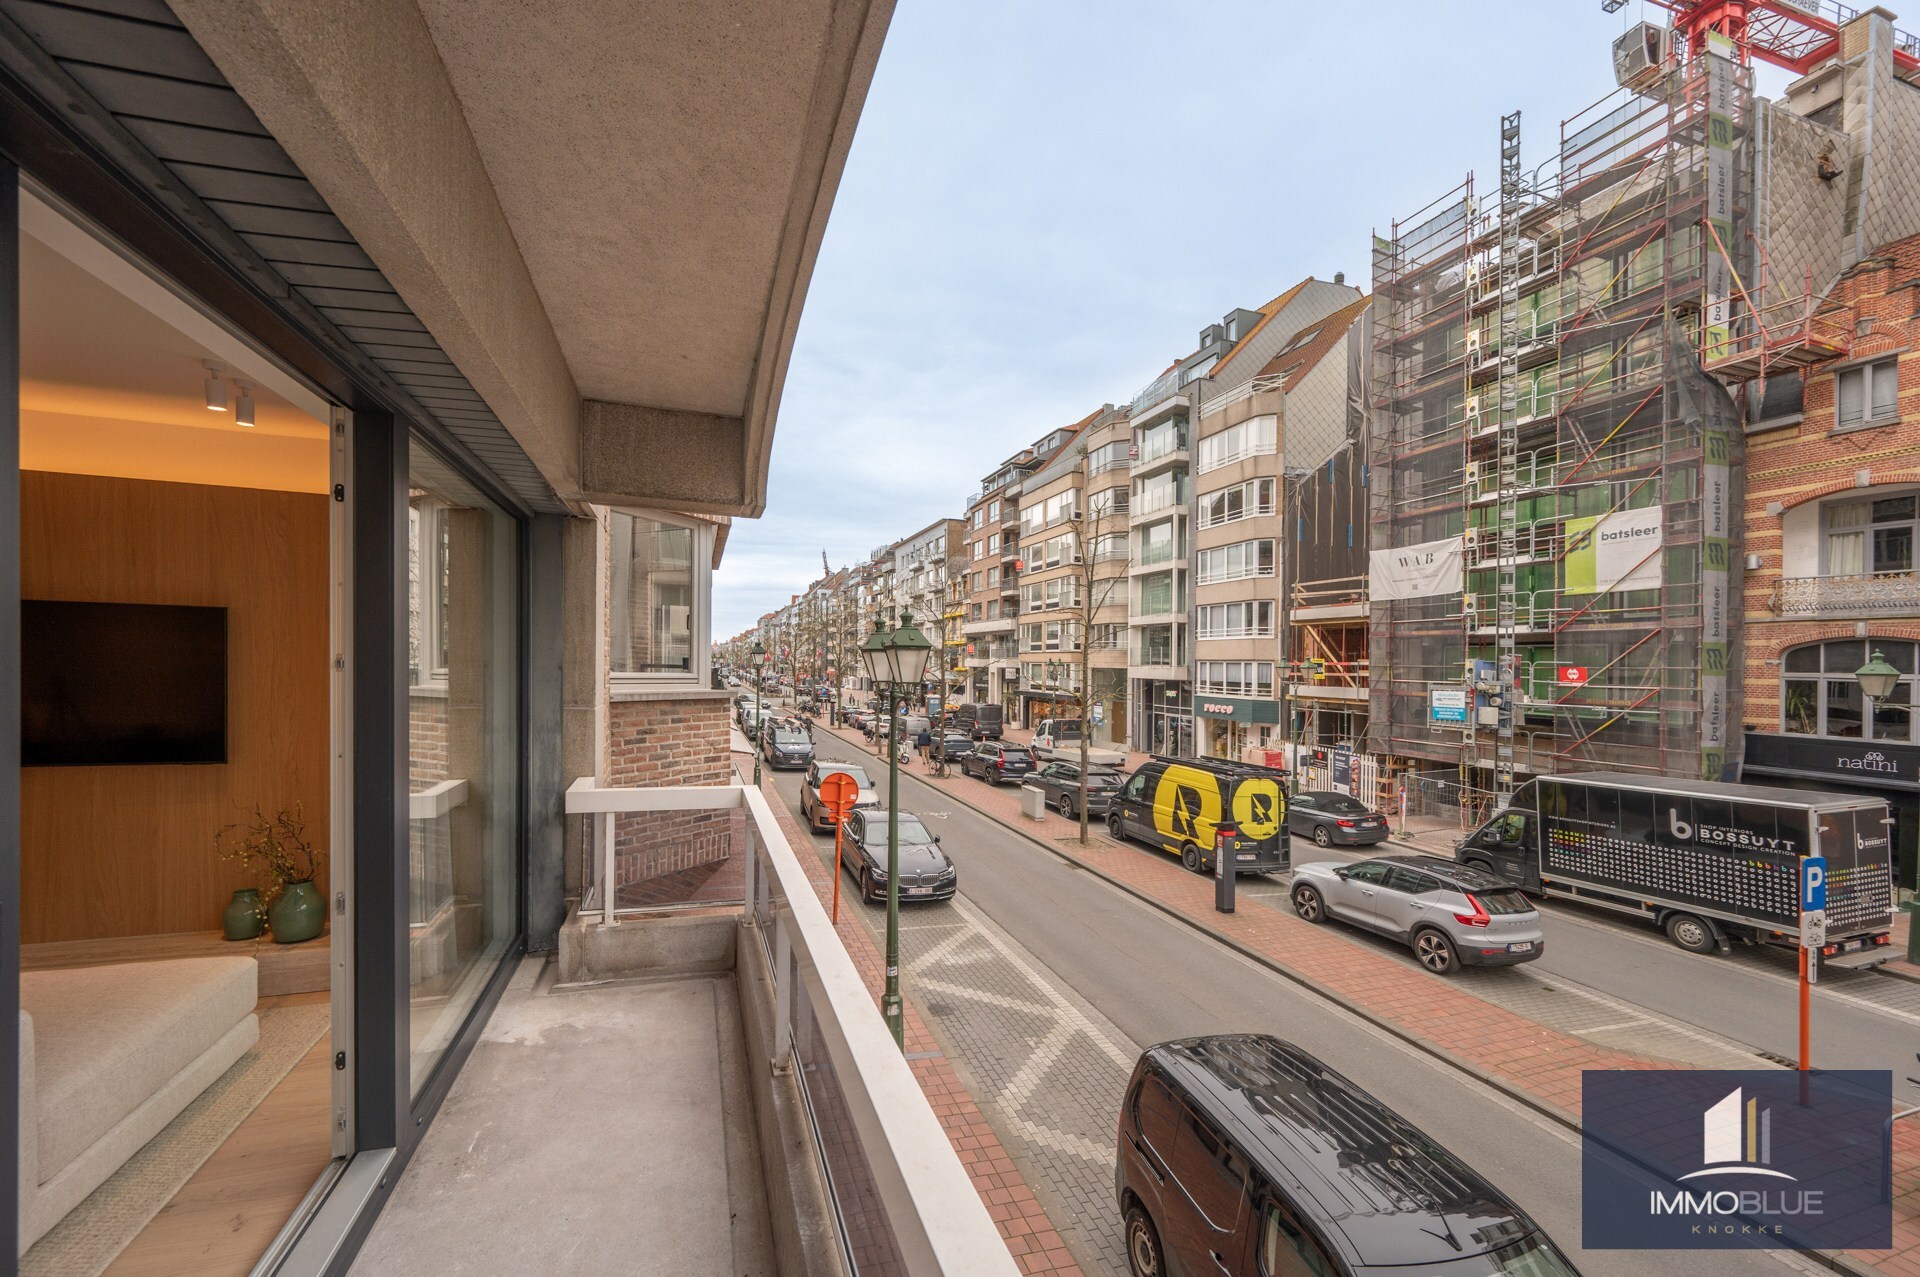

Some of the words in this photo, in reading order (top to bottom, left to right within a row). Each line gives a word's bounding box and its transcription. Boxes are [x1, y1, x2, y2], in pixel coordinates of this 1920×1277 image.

[1717, 165, 1726, 215] batsleer
[1601, 526, 1658, 541] batsleer
[1712, 586, 1721, 637] batsleer
[1203, 703, 1234, 715] rocco
[1710, 692, 1720, 742] batsleer
[1836, 756, 1899, 773] natini
[1553, 828, 1585, 838] PHARMA
[1553, 834, 1585, 843] HORECA
[1718, 826, 1754, 836] INTERIORS
[1554, 838, 1574, 846] FOOD
[1700, 829, 1795, 851] BOSSUYT
[1700, 838, 1731, 847] CONCEPT
[1733, 842, 1758, 851] DESIGN
[1760, 846, 1796, 857] CREATION
[1554, 848, 1585, 857] BEAUTY
[1807, 866, 1823, 903] P
